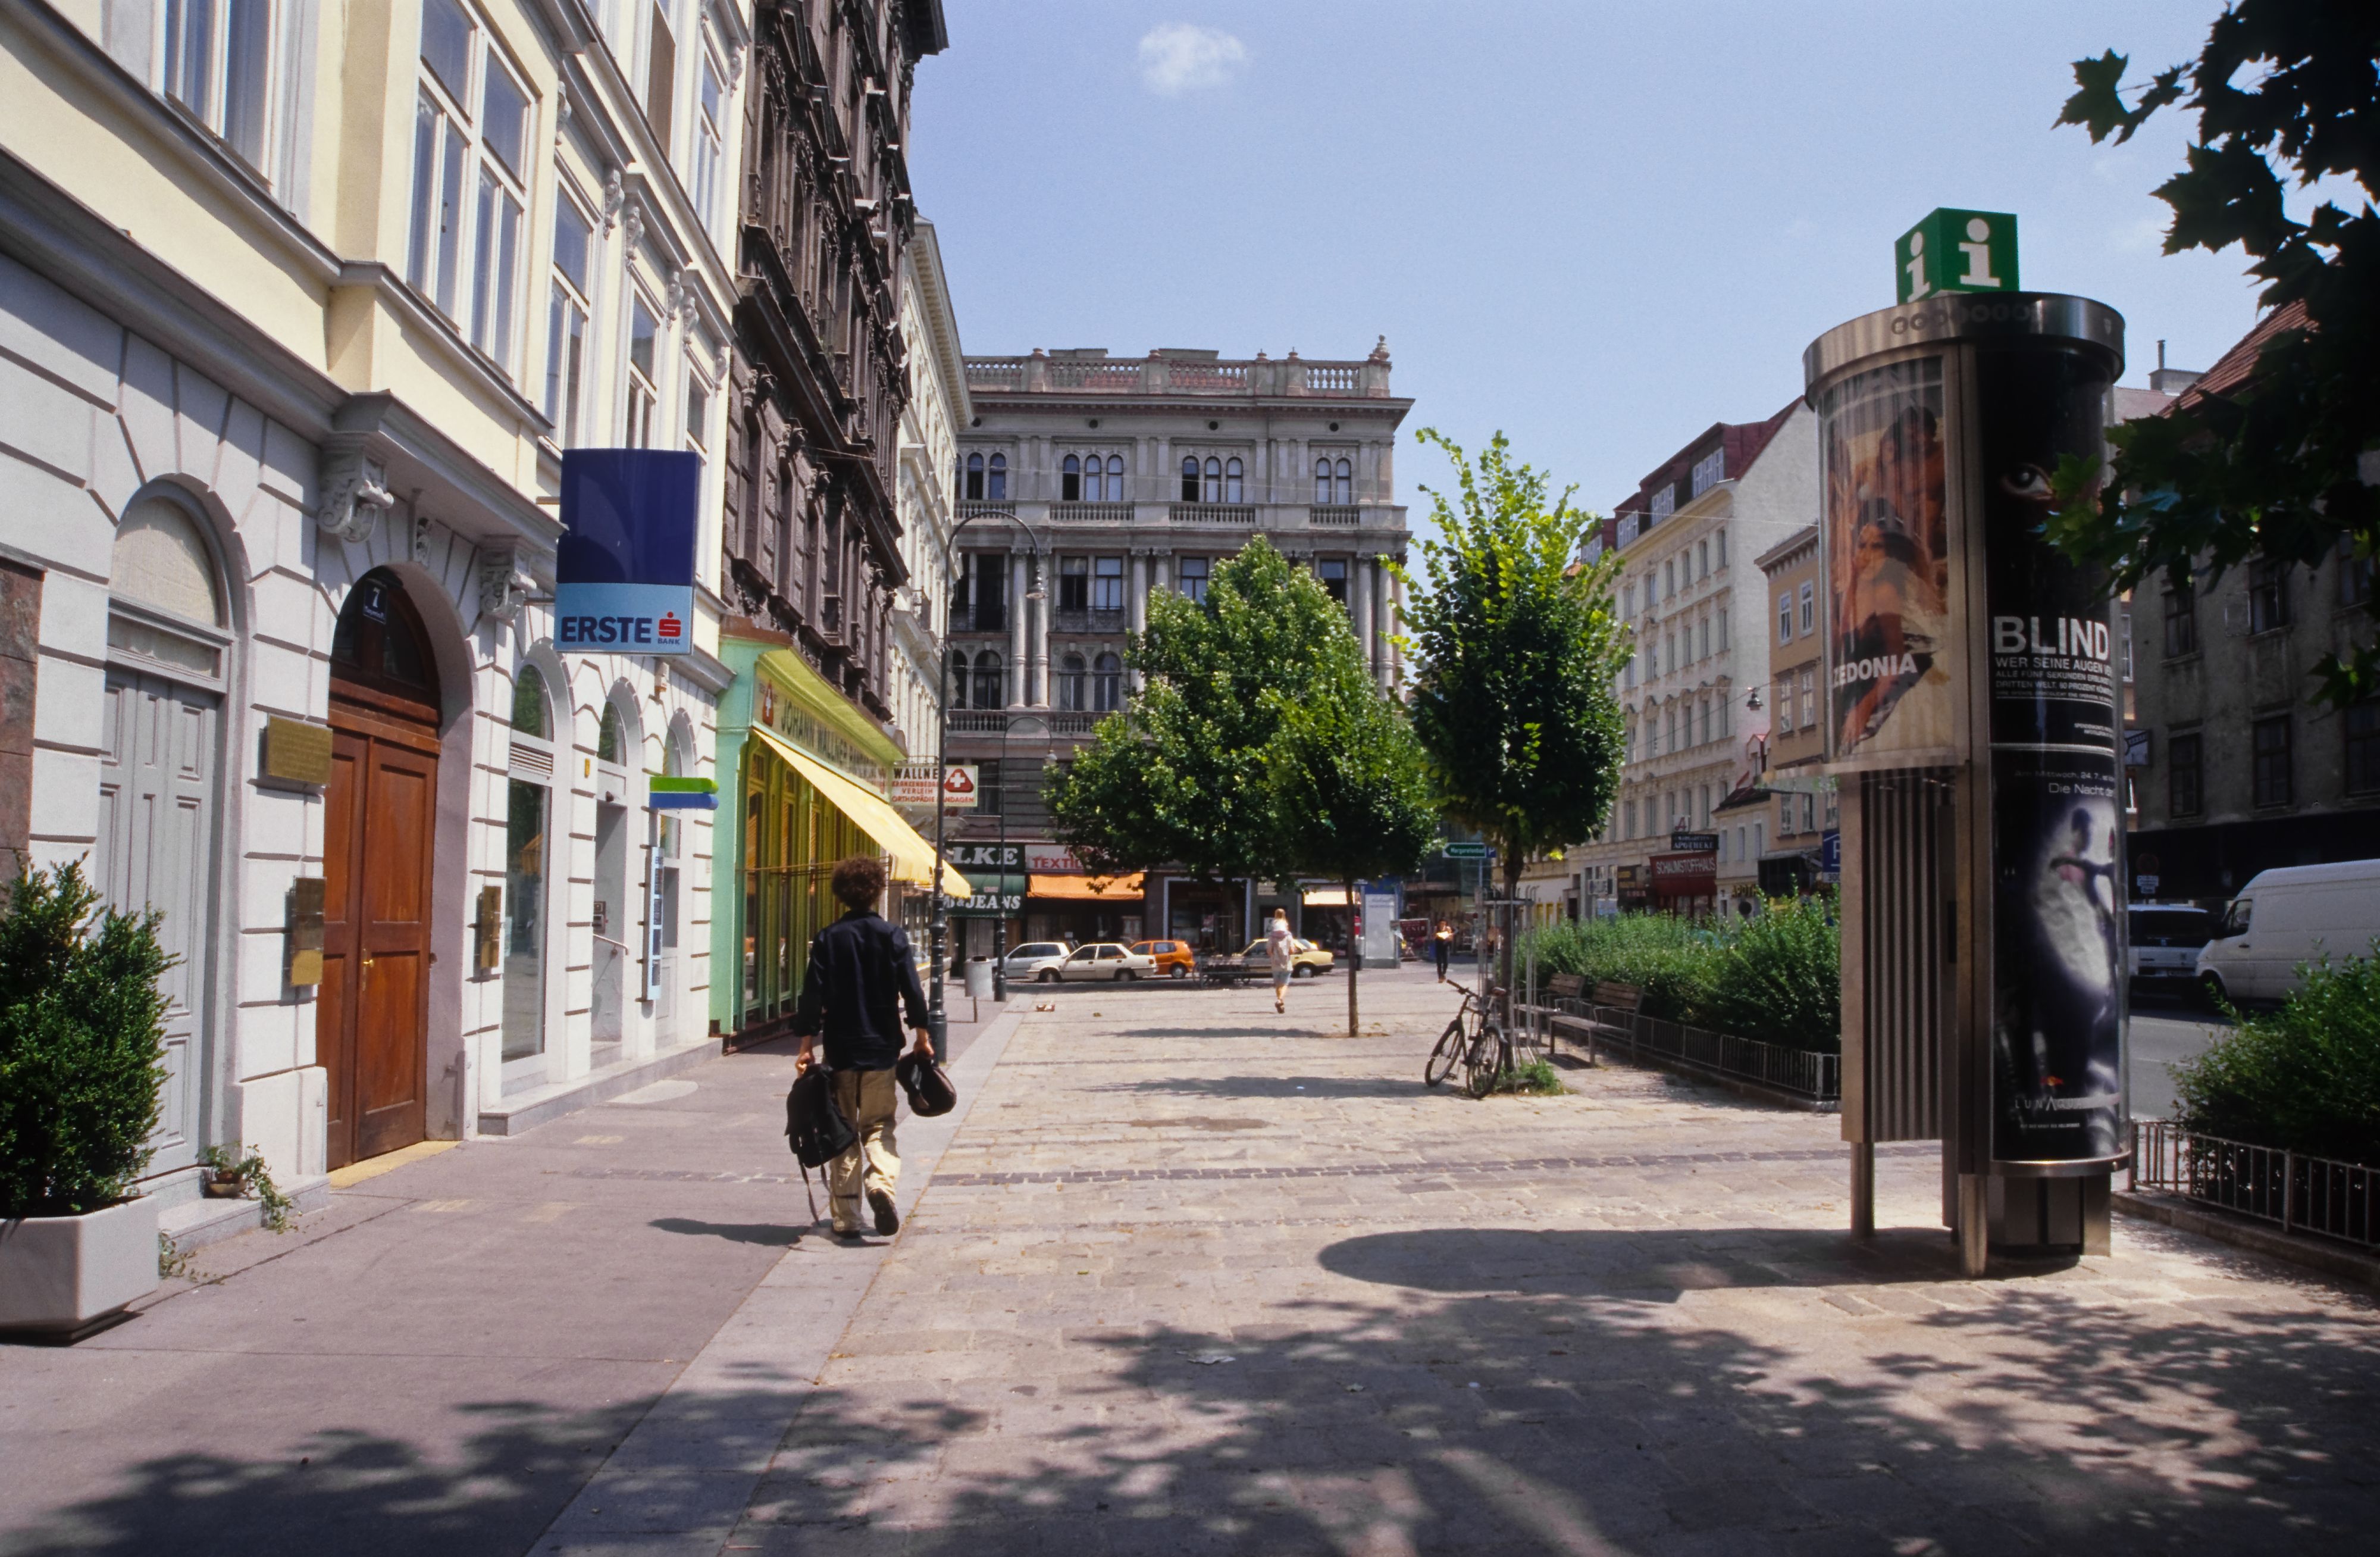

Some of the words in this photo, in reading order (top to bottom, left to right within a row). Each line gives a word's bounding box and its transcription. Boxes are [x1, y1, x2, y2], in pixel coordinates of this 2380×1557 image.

[373, 587, 381, 608] 7
[560, 617, 652, 643] ERSTE
[1994, 616, 2109, 661] BLIND
[1995, 657, 2028, 667] WER
[2033, 657, 2070, 670] SEINE
[2073, 659, 2103, 674] AUGEN
[2022, 669, 2044, 678] FÜNF
[2047, 671, 2086, 680] SEKUNDEN
[894, 767, 947, 779] WALLNE
[2049, 783, 2070, 793] Die
[2074, 784, 2104, 796] Nacht
